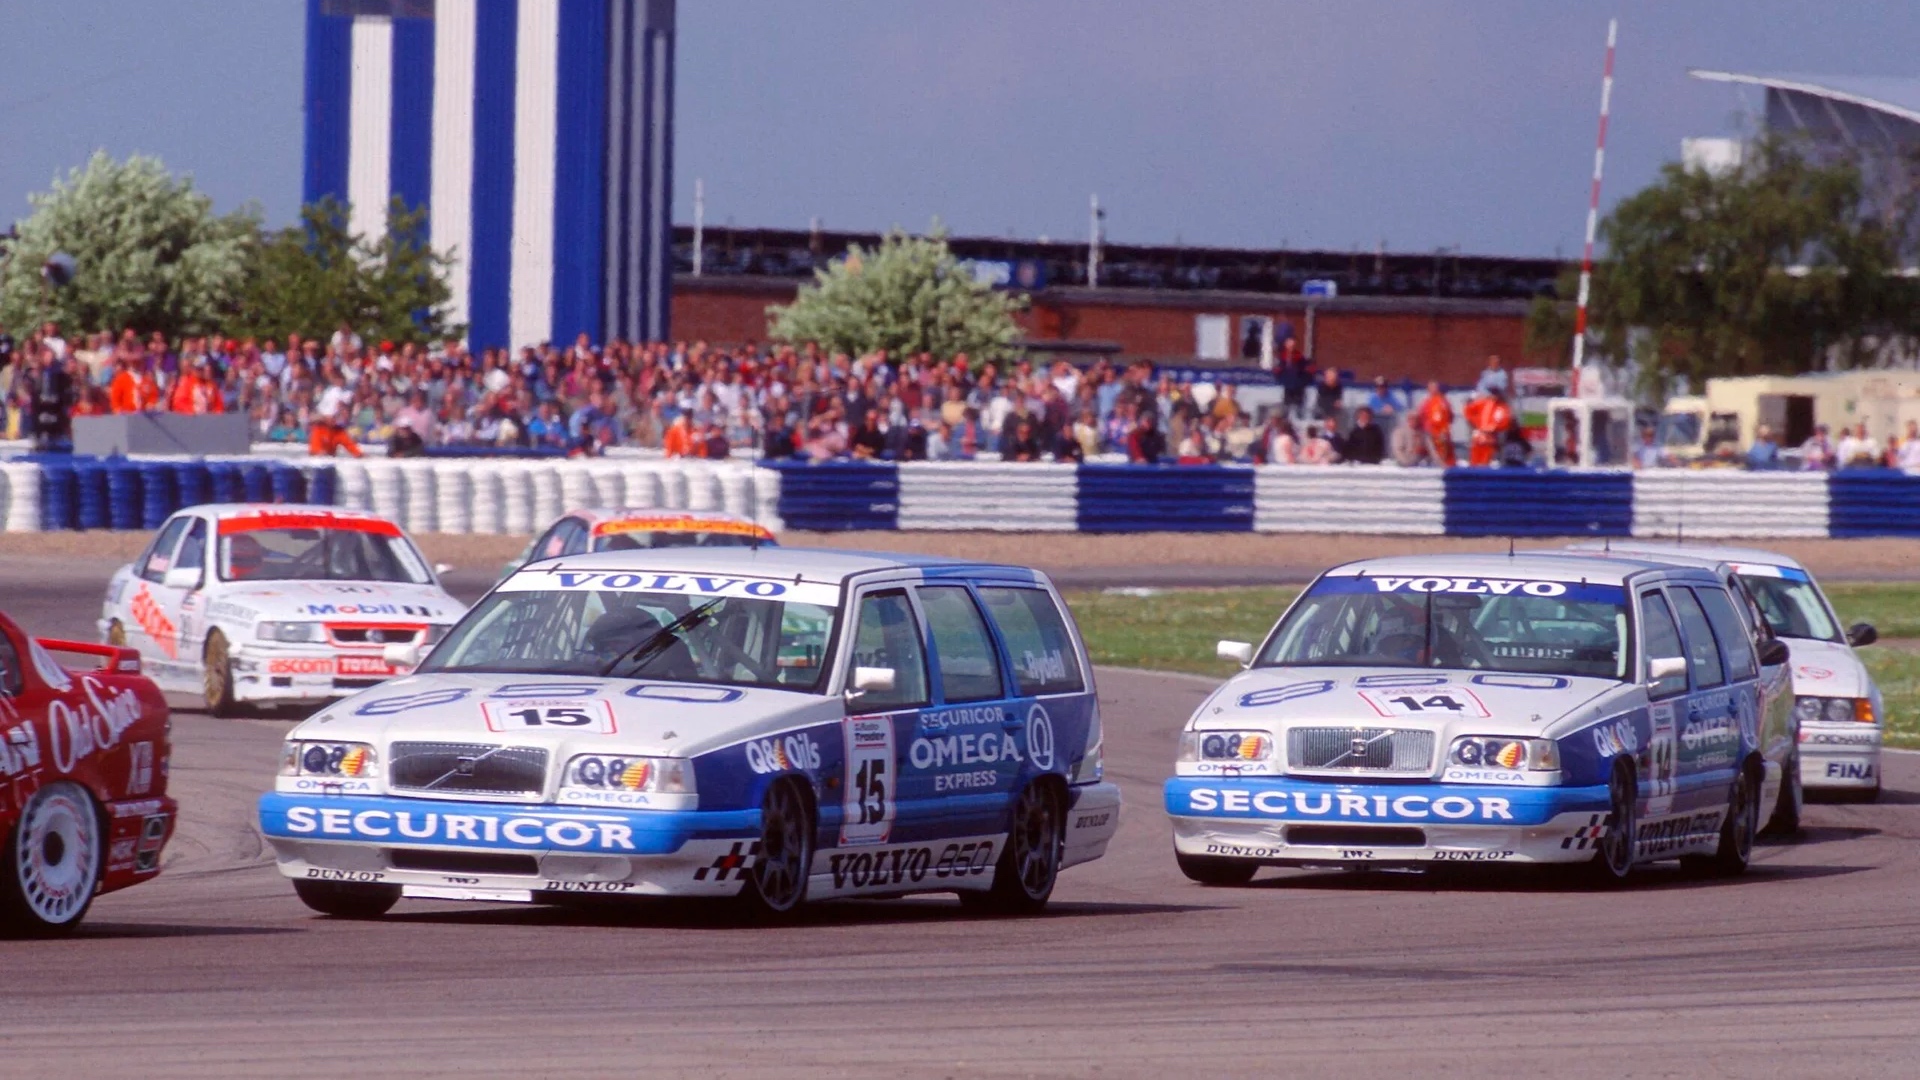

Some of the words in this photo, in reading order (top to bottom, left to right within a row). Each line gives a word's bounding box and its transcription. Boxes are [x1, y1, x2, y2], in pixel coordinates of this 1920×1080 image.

[556, 573, 787, 597] VOLVO
[1371, 577, 1567, 597] VOLVO
[306, 604, 397, 616] Mobil
[268, 658, 333, 675] ascom
[1389, 695, 1466, 711] 14
[508, 708, 593, 727] 15
[920, 707, 1006, 730] SECURICOR
[784, 732, 821, 770] Oils
[909, 732, 1025, 770] OMEGA
[1202, 733, 1243, 758] Q8
[1458, 738, 1502, 767] Q8
[304, 744, 347, 774] Q8
[579, 756, 626, 787] Q8
[935, 770, 998, 792] EXPRESS
[1448, 770, 1526, 782] OMEGA
[1826, 763, 1874, 779] FINA
[566, 790, 651, 804] OMEGA
[855, 759, 886, 824] 15
[1190, 788, 1514, 820] SECURICOR
[286, 806, 636, 850] SECURICOR
[1075, 813, 1110, 829] DUNLOP
[1206, 844, 1281, 858] DUNLOP
[1432, 850, 1514, 861] DUNLOP
[306, 868, 385, 882] DUNLOP
[829, 847, 932, 890] VOLVO
[935, 840, 994, 879] 850
[546, 881, 636, 892] DUNLOP
